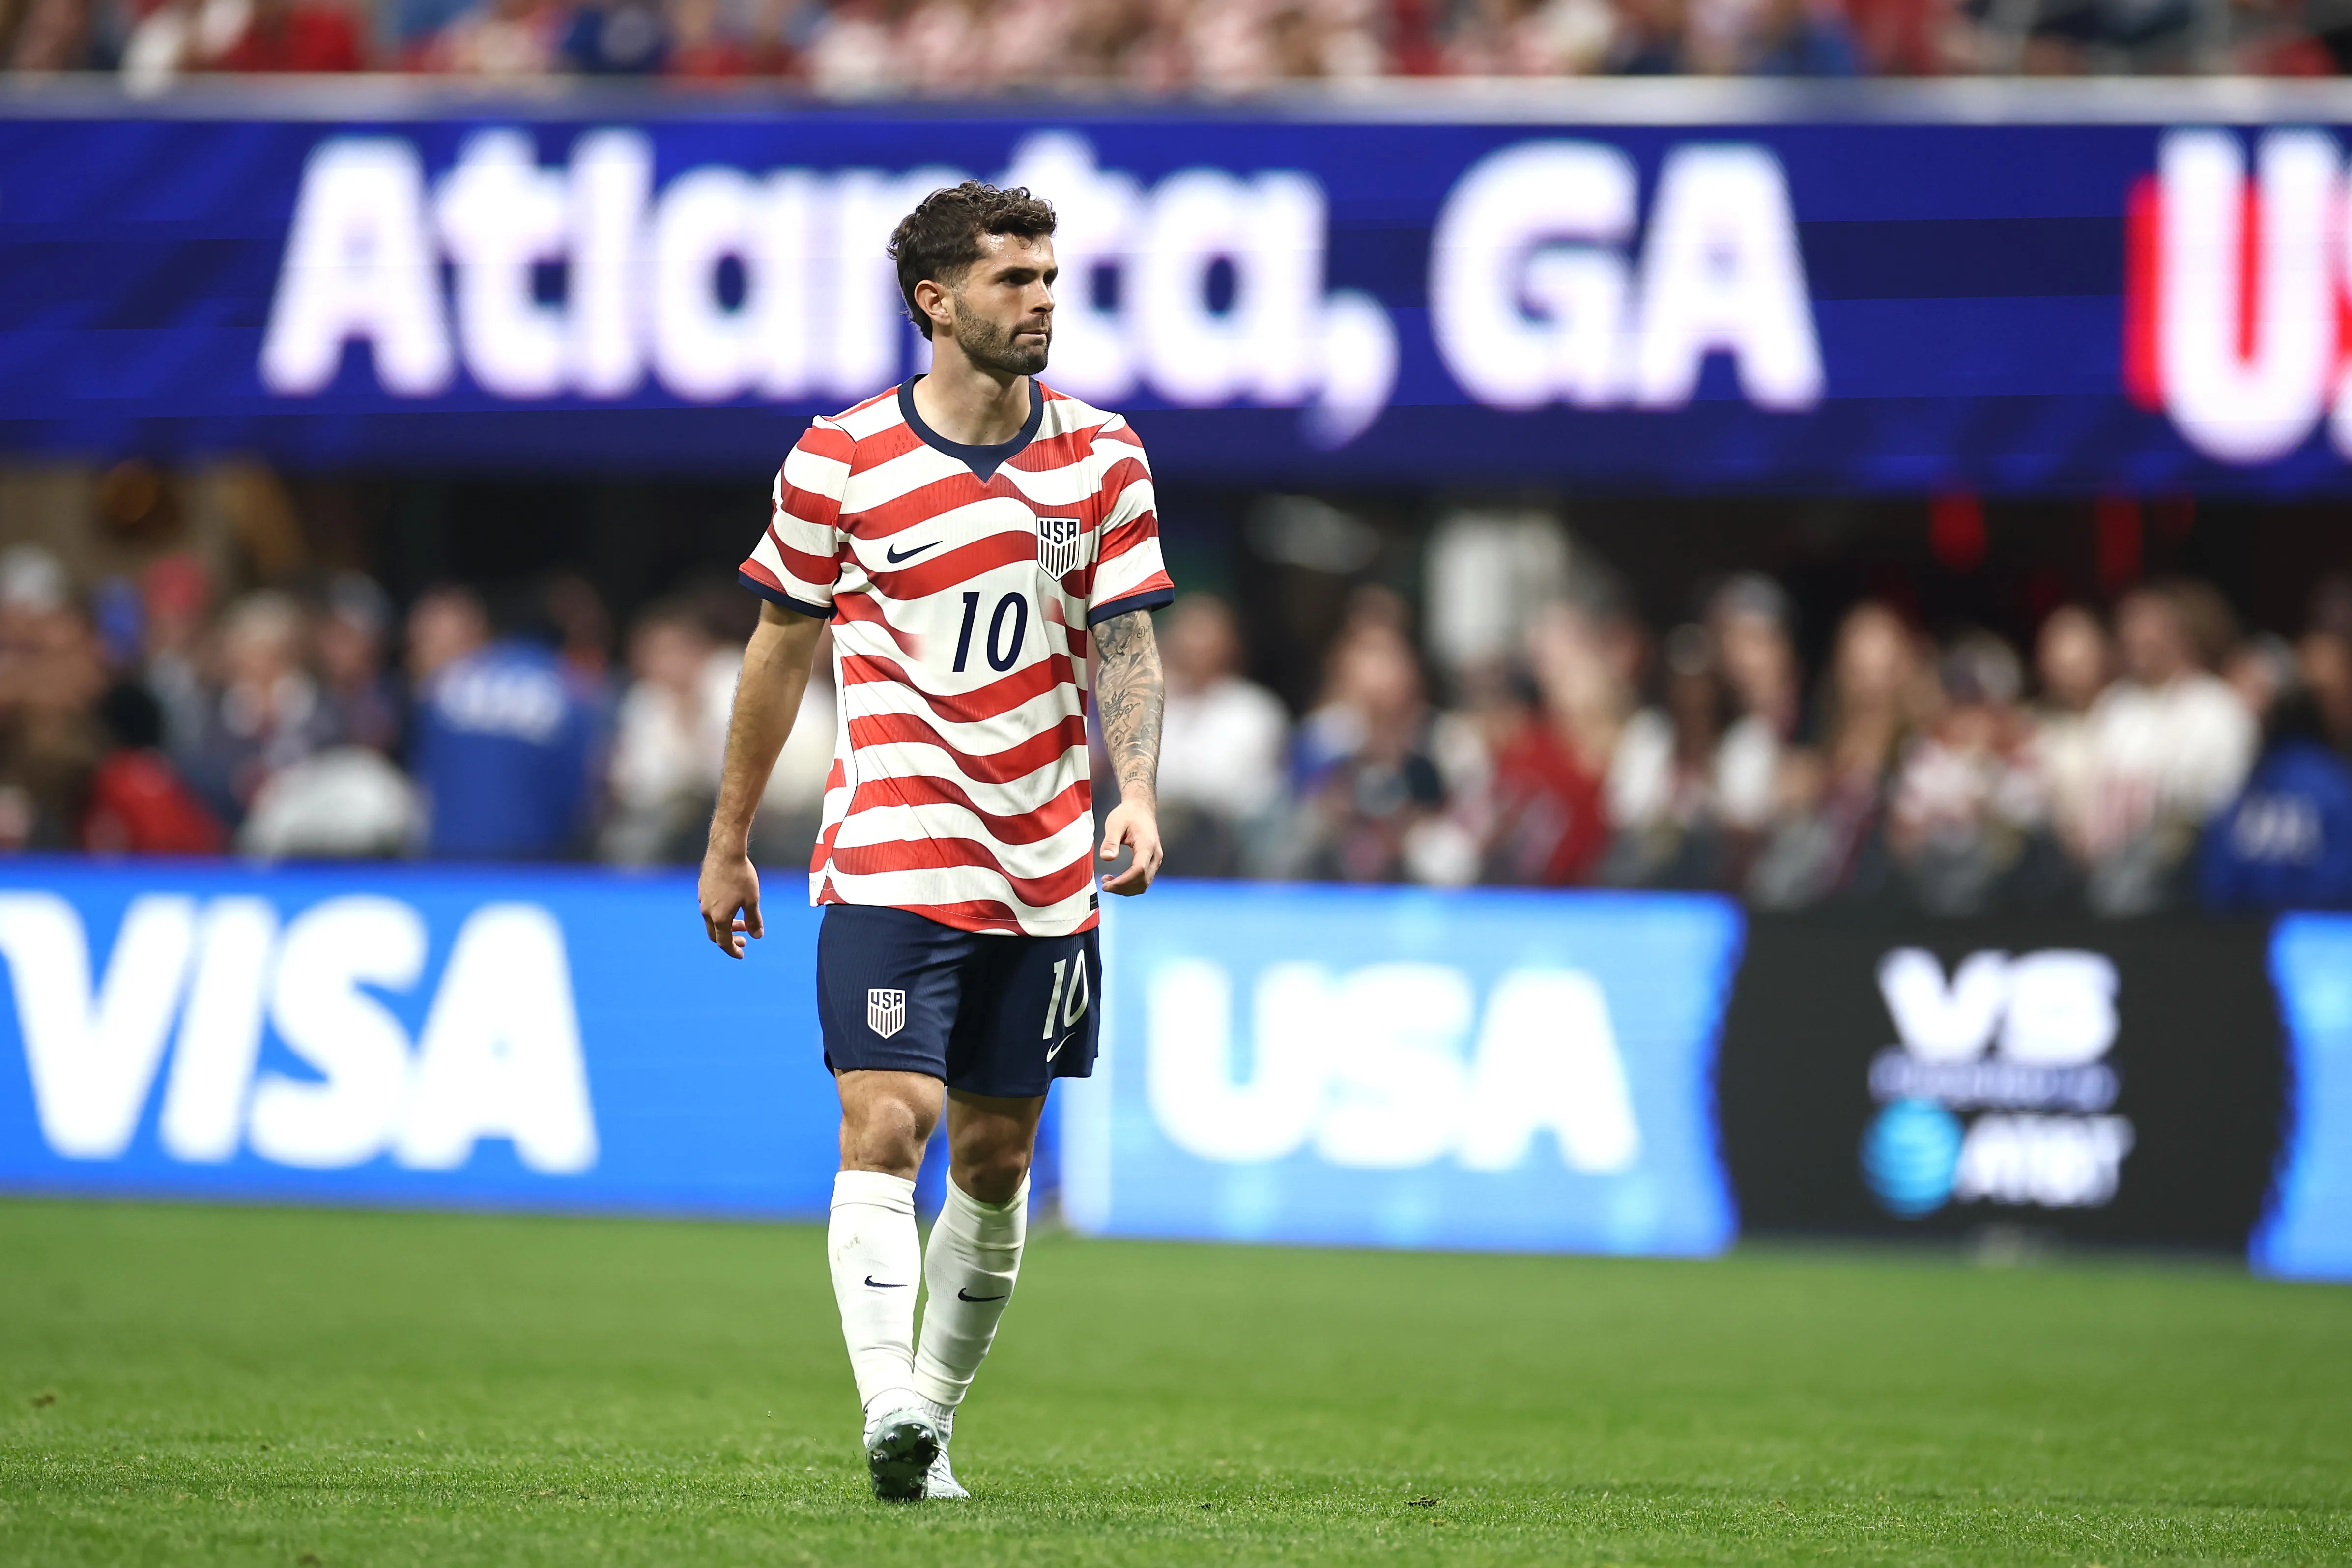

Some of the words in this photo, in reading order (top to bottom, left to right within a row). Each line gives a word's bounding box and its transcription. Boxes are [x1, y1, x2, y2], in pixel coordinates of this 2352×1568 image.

[1430, 137, 1824, 412] GA
[1040, 521, 1077, 545] USA
[952, 591, 1028, 672] 10
[0, 890, 600, 1175] VISA
[871, 992, 903, 1010] USA
[1042, 949, 1089, 1040] 10
[1145, 956, 1639, 1175] USA
